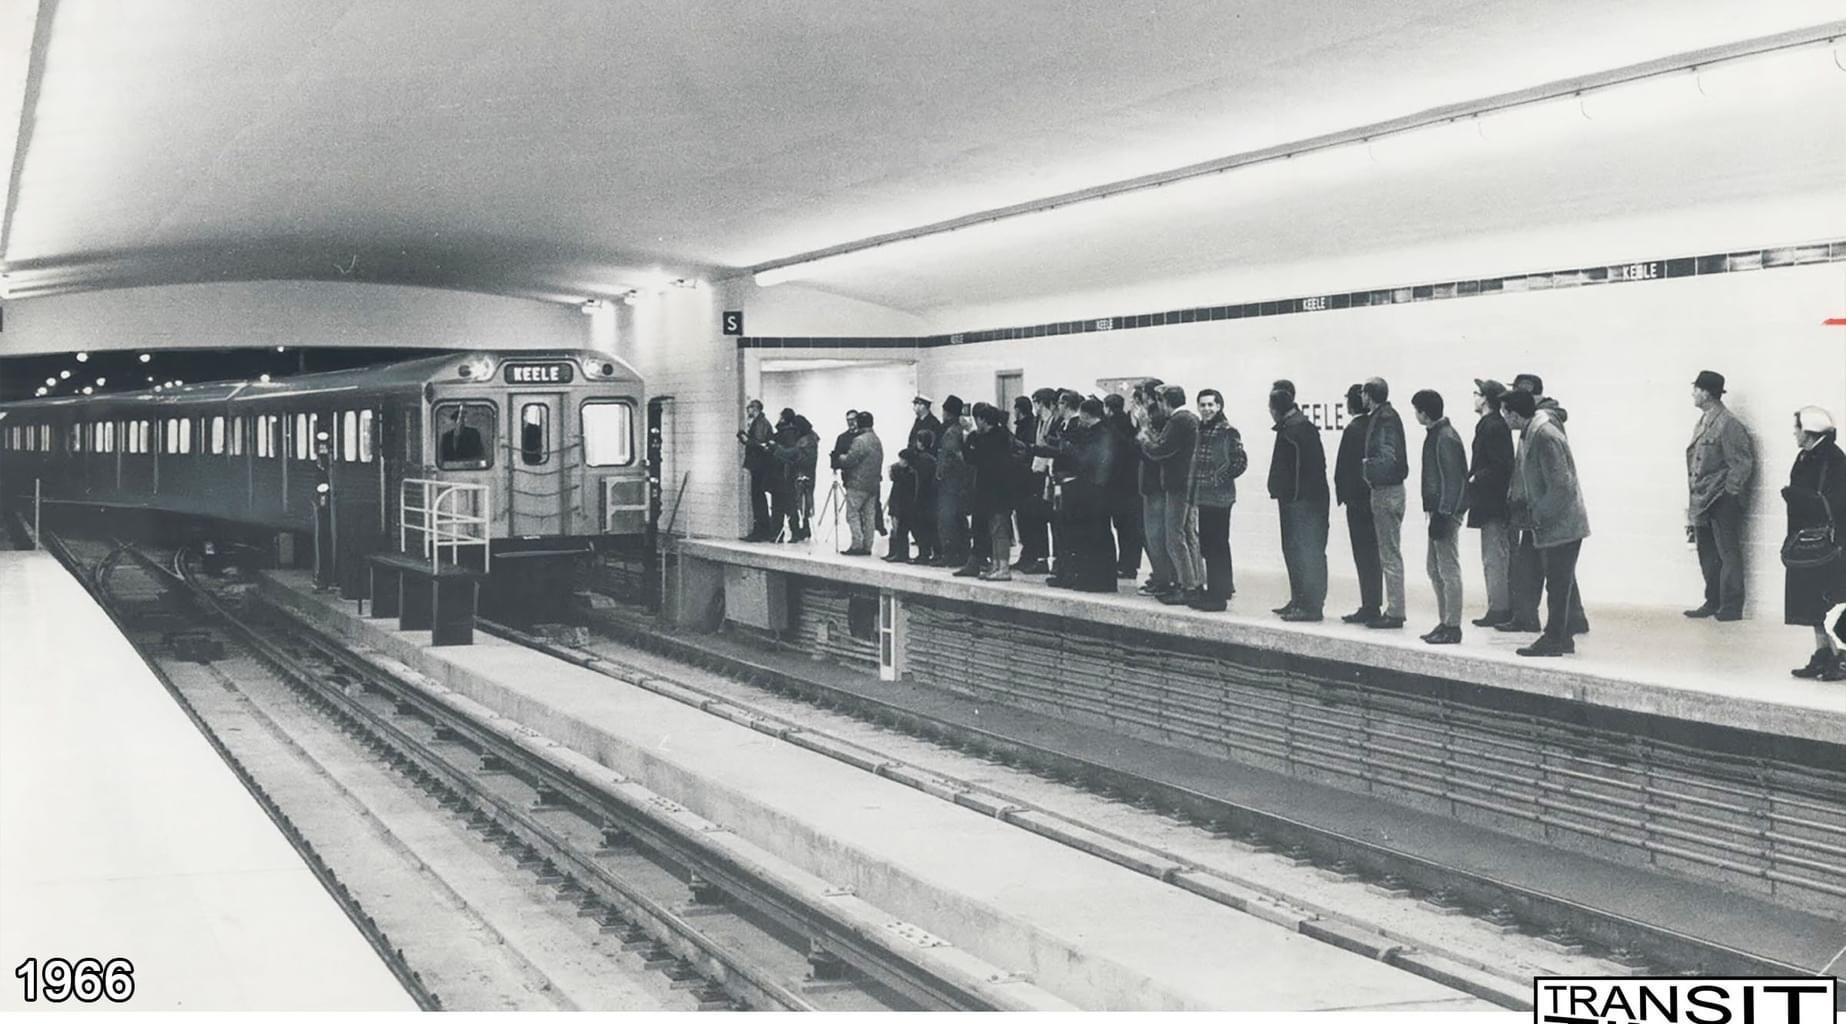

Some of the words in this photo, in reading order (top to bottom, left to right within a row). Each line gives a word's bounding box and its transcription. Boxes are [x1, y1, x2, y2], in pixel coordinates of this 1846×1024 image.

[1623, 263, 1657, 280] KEELE
[727, 315, 737, 331] S
[513, 366, 559, 381] KEELE
[1301, 404, 1344, 431] ELE
